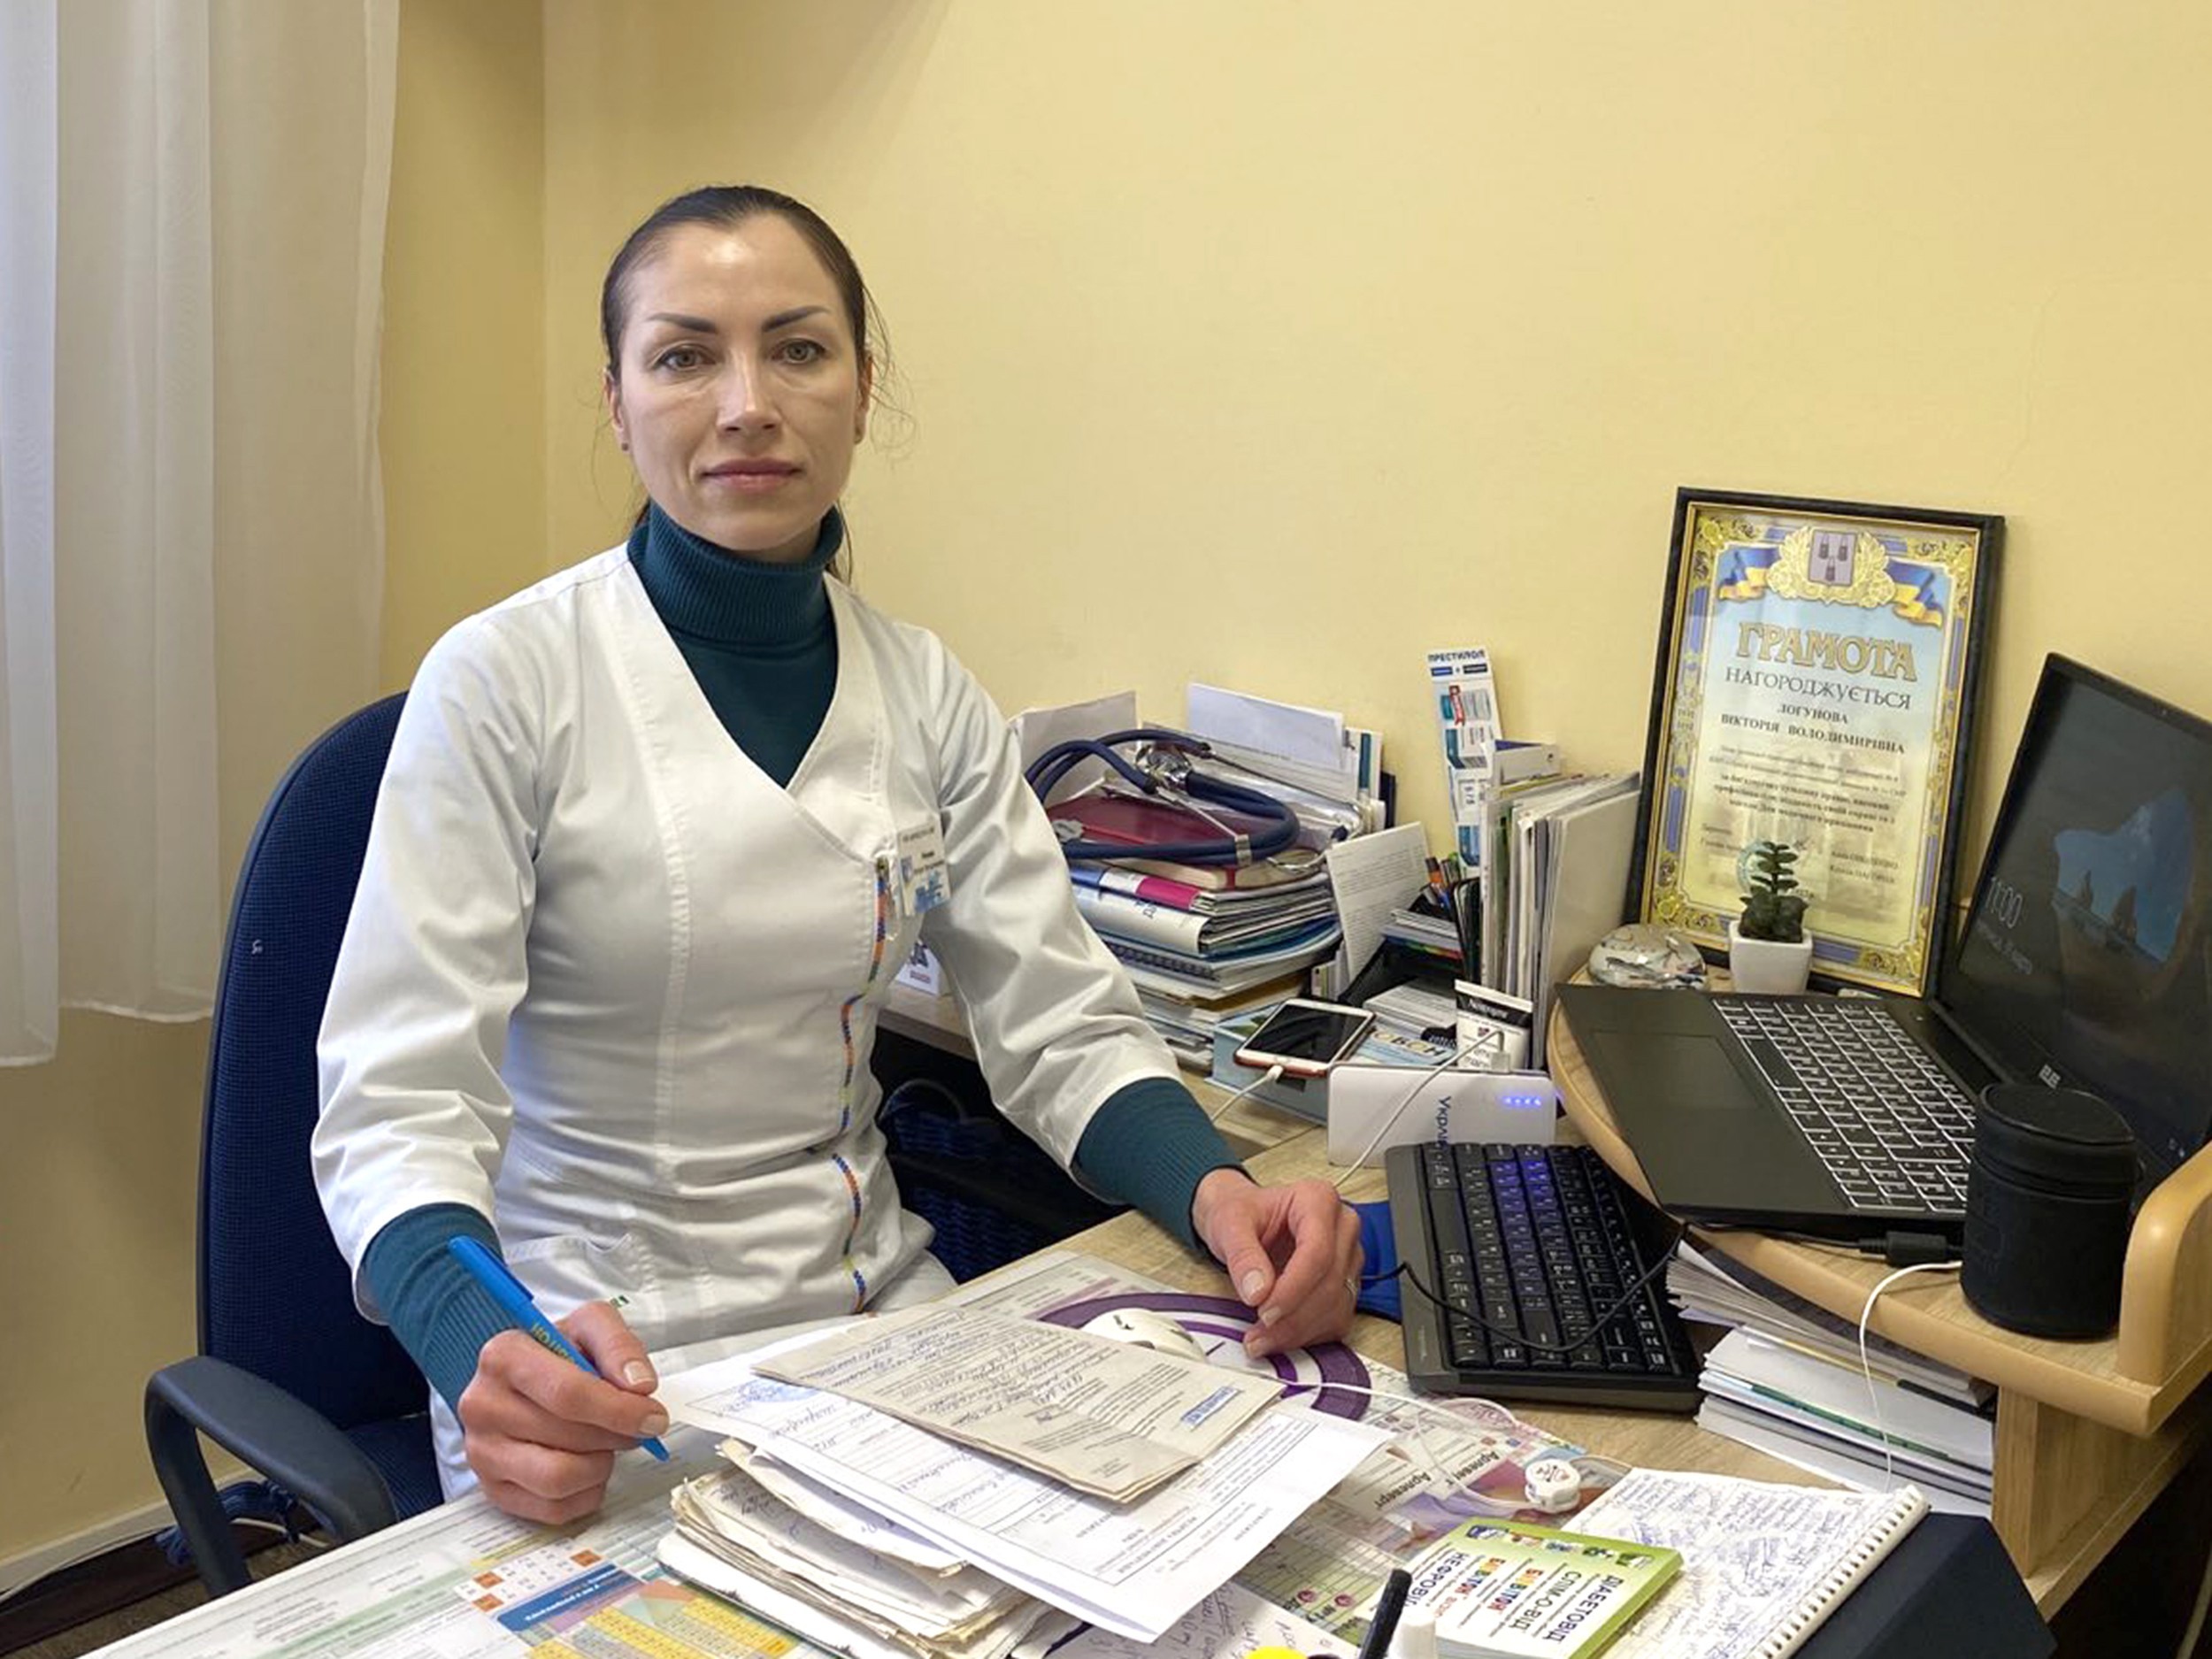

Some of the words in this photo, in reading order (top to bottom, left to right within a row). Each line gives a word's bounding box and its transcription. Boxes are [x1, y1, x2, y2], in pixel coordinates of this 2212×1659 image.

[1736, 622, 1917, 681] ГРАМОТА
[1725, 666, 1911, 710] НАГОРОДЖУЄТЬСЯ
[1721, 713, 1780, 733] ВІКТОРІЯ
[1788, 726, 1905, 754] ВОЛОДИМИРІВНА
[1778, 704, 1848, 725] ЛОГУНОВА
[1509, 1570, 1582, 1631] СЛІМ-О-ВІД
[1543, 1574, 1624, 1643] ДІАБЕТОВІД
